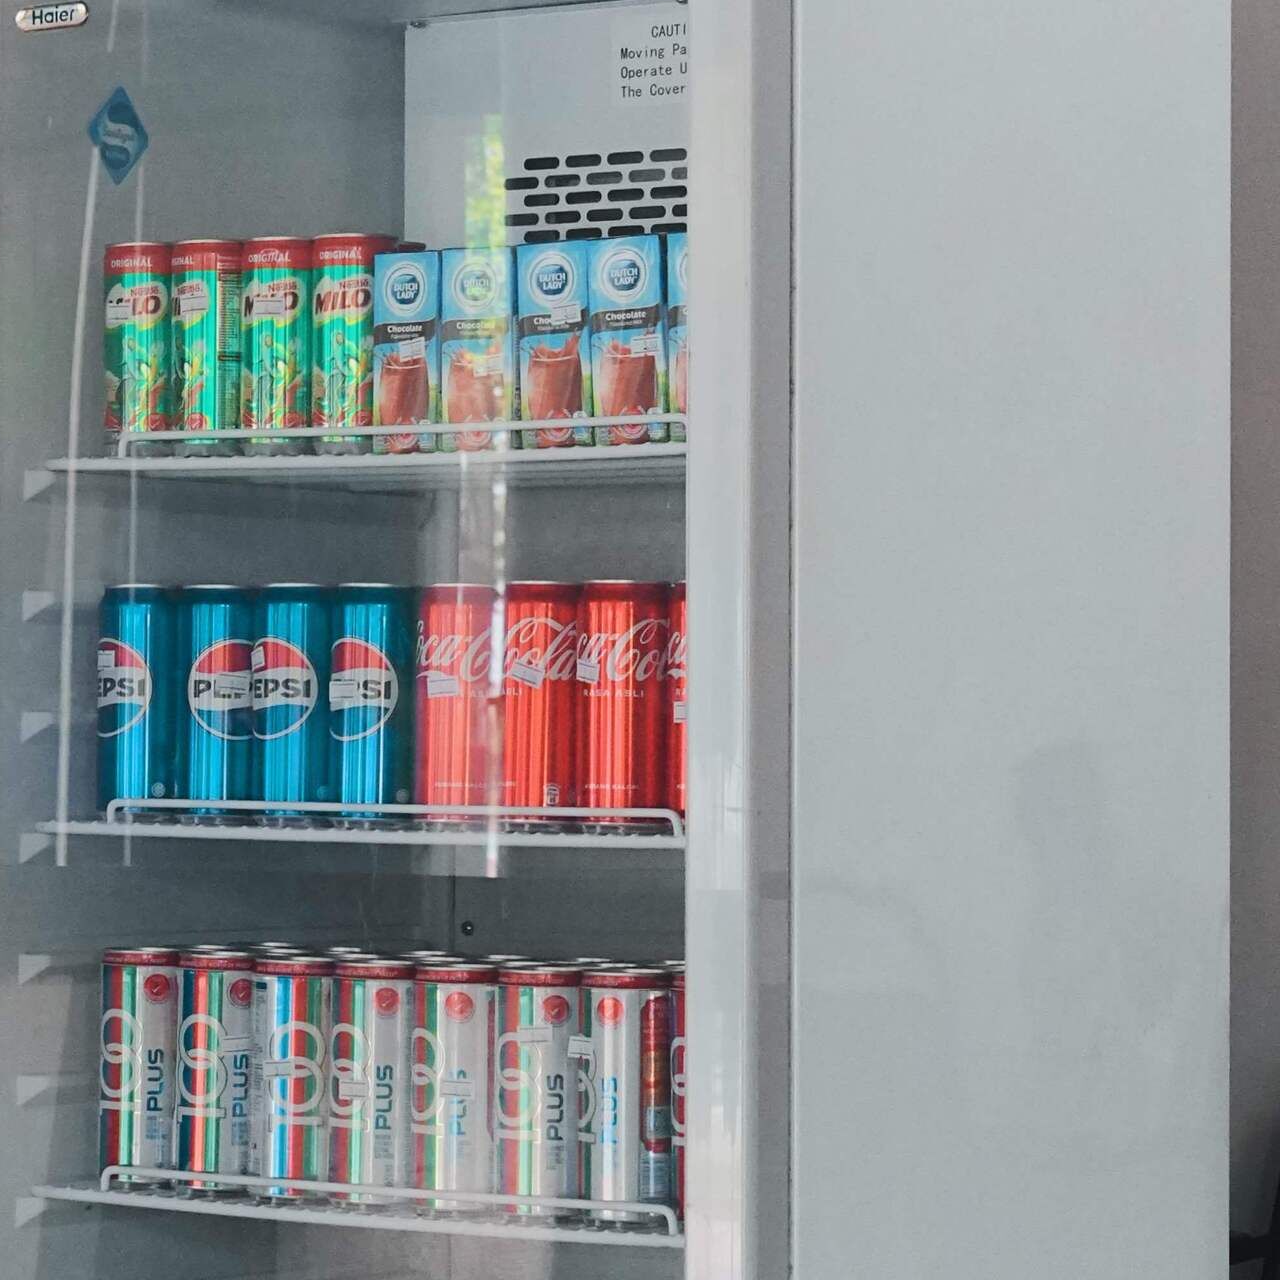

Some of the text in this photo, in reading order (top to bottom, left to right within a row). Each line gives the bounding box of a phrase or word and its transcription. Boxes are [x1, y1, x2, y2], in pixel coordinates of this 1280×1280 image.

[32, 5, 76, 25] Haier
[651, 23, 687, 38] CAUTI
[620, 43, 687, 60] Moving Pa
[620, 62, 687, 80] Operate U
[621, 83, 686, 98] The Cover
[111, 255, 153, 268] ORIGINAL
[542, 279, 564, 290] LADY
[613, 276, 636, 286] LADY
[314, 287, 372, 315] MILO
[605, 310, 647, 321] Chocolate
[387, 324, 423, 334] Chocolate
[147, 1048, 164, 1113] PLUS
[232, 1053, 249, 1118] PLUS
[374, 1064, 394, 1131] PLUS
[546, 1073, 564, 1142] PLUS
